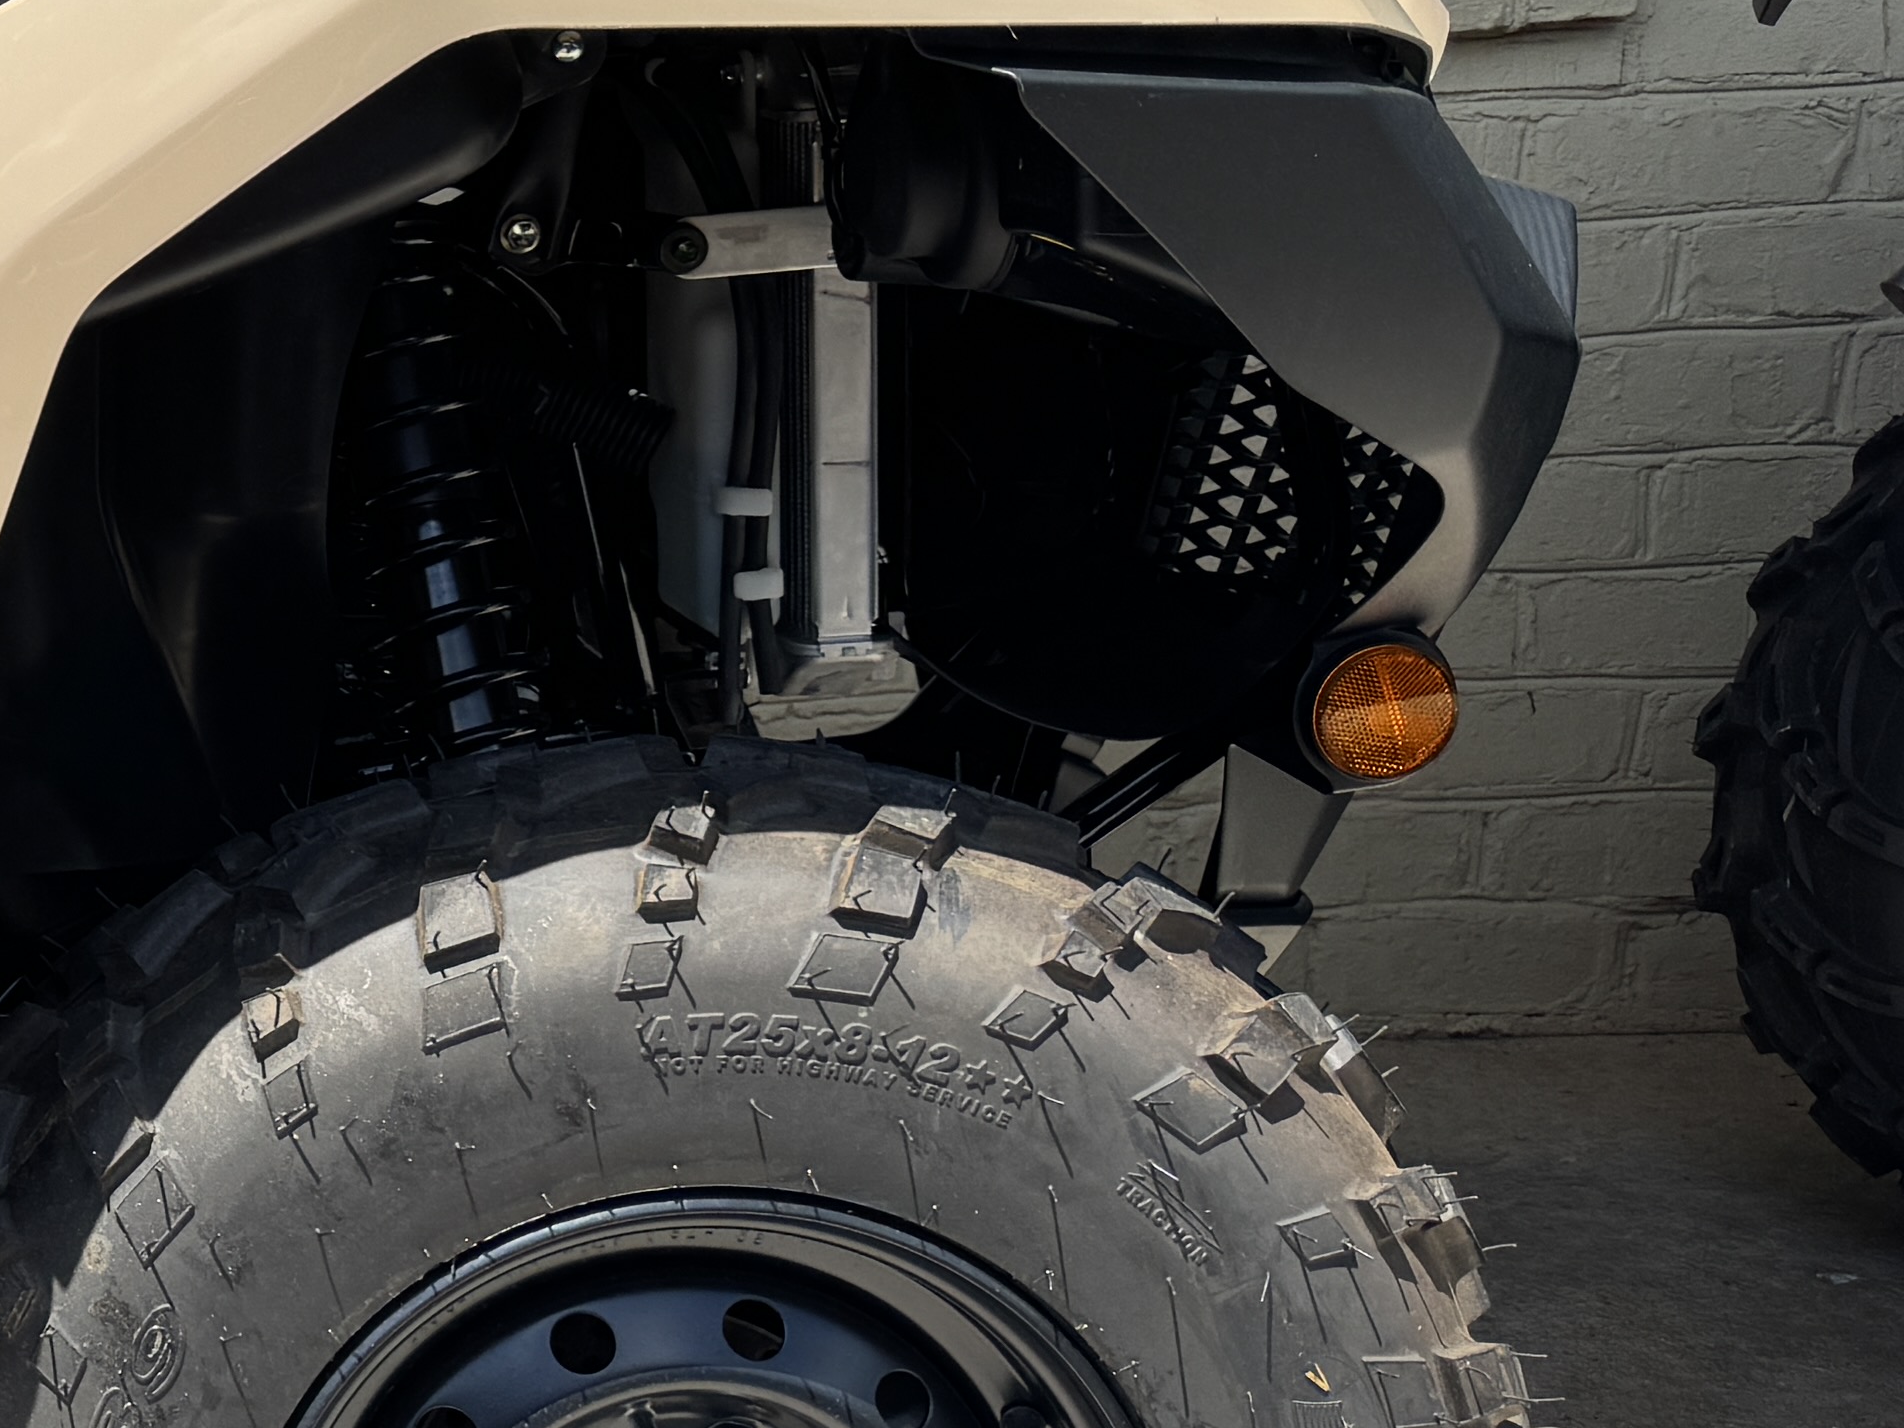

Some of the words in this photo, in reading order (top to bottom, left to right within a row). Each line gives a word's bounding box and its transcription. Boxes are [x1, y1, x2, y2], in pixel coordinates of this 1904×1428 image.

[717, 1053, 766, 1075] FOR
[778, 1056, 901, 1094] HIGHWAY
[907, 1078, 1015, 1130] SERVICE
